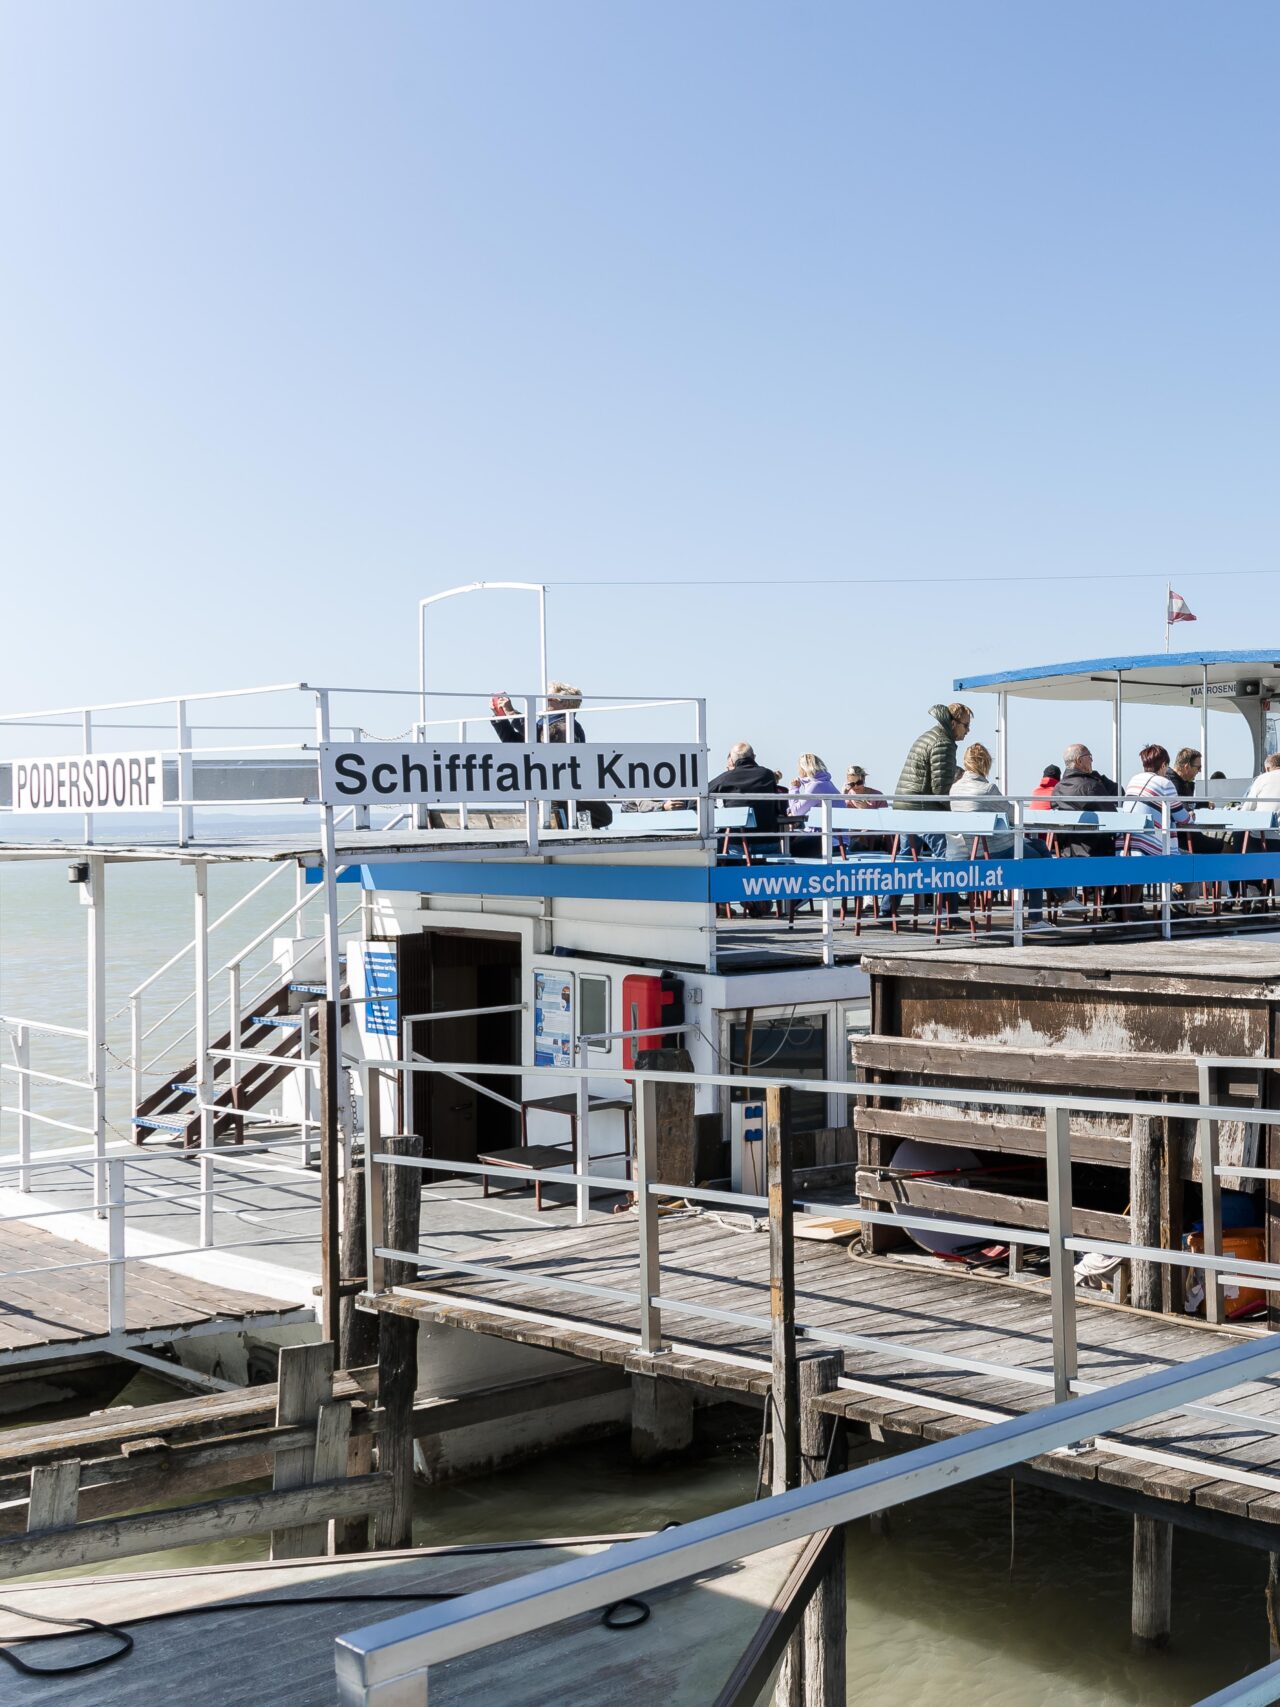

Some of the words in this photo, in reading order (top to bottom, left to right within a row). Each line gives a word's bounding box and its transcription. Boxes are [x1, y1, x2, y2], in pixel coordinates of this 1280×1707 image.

[1190, 684, 1237, 695] MAROSEN
[17, 757, 156, 809] PODERSDORF
[335, 753, 581, 794] Schifffahrt
[597, 753, 699, 789] Knoll
[742, 865, 1004, 896] www.schifffahrt-knoll.at
